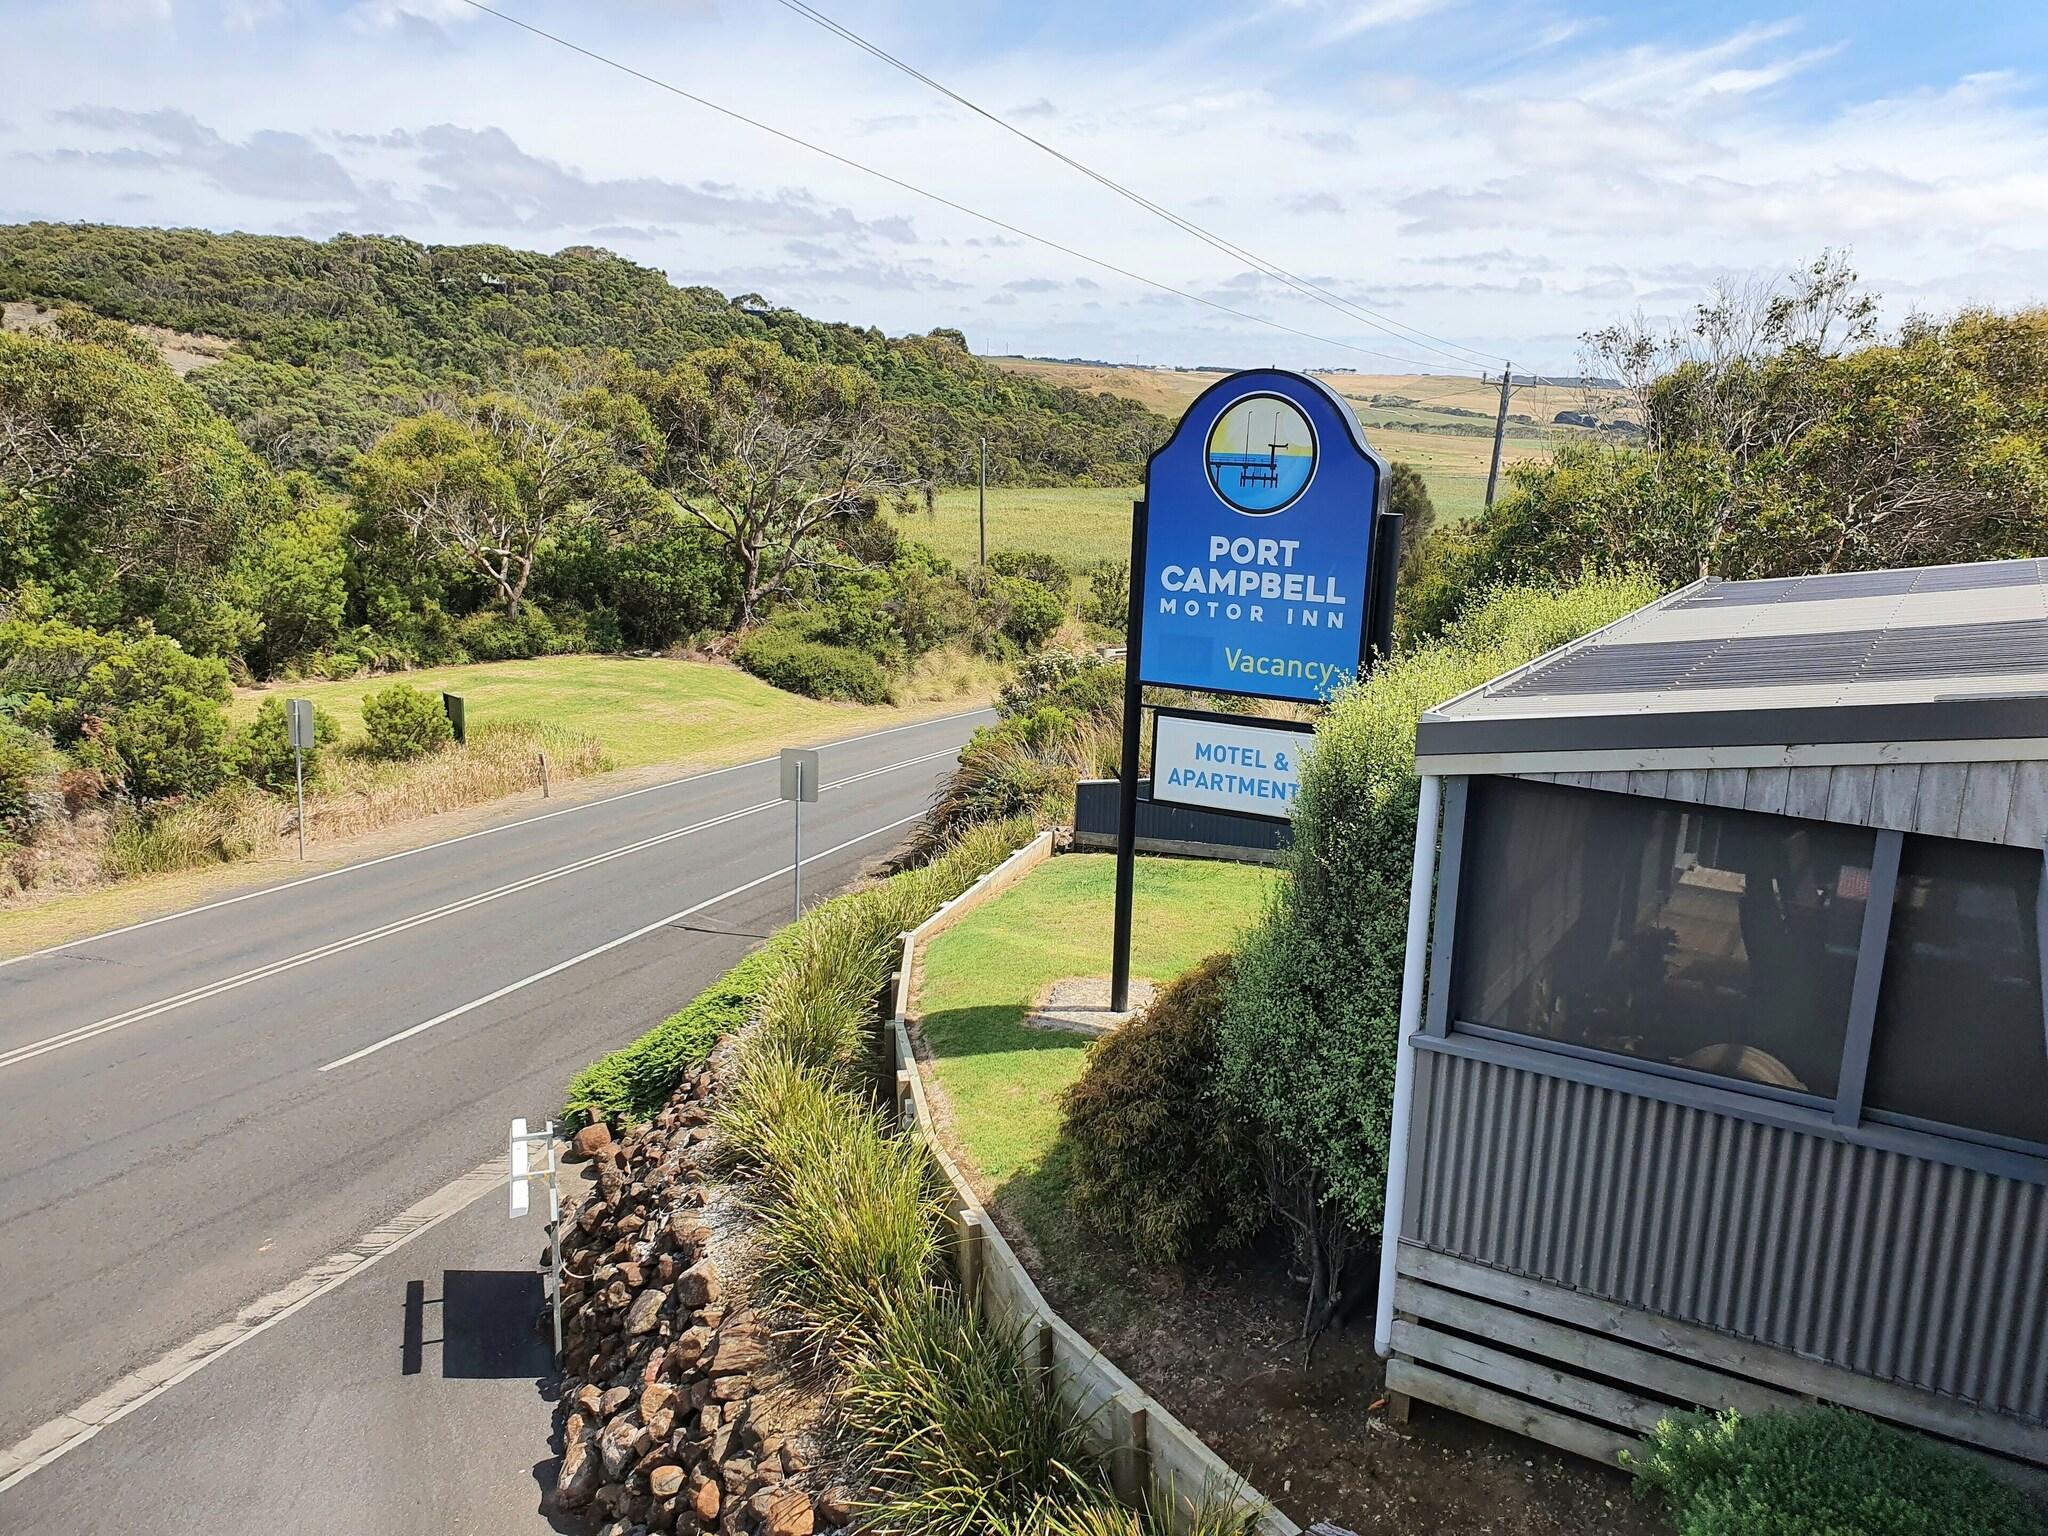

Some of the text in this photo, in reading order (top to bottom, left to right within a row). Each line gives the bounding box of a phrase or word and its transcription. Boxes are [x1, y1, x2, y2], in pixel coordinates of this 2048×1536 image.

[1209, 536, 1300, 567] PORT
[1160, 565, 1346, 605] CAMPBELL
[1159, 598, 1344, 629] MOTOR INN
[1225, 647, 1334, 686] Vacancy
[1195, 742, 1289, 772] MOTEL &
[1167, 767, 1302, 801] APARTMENT
